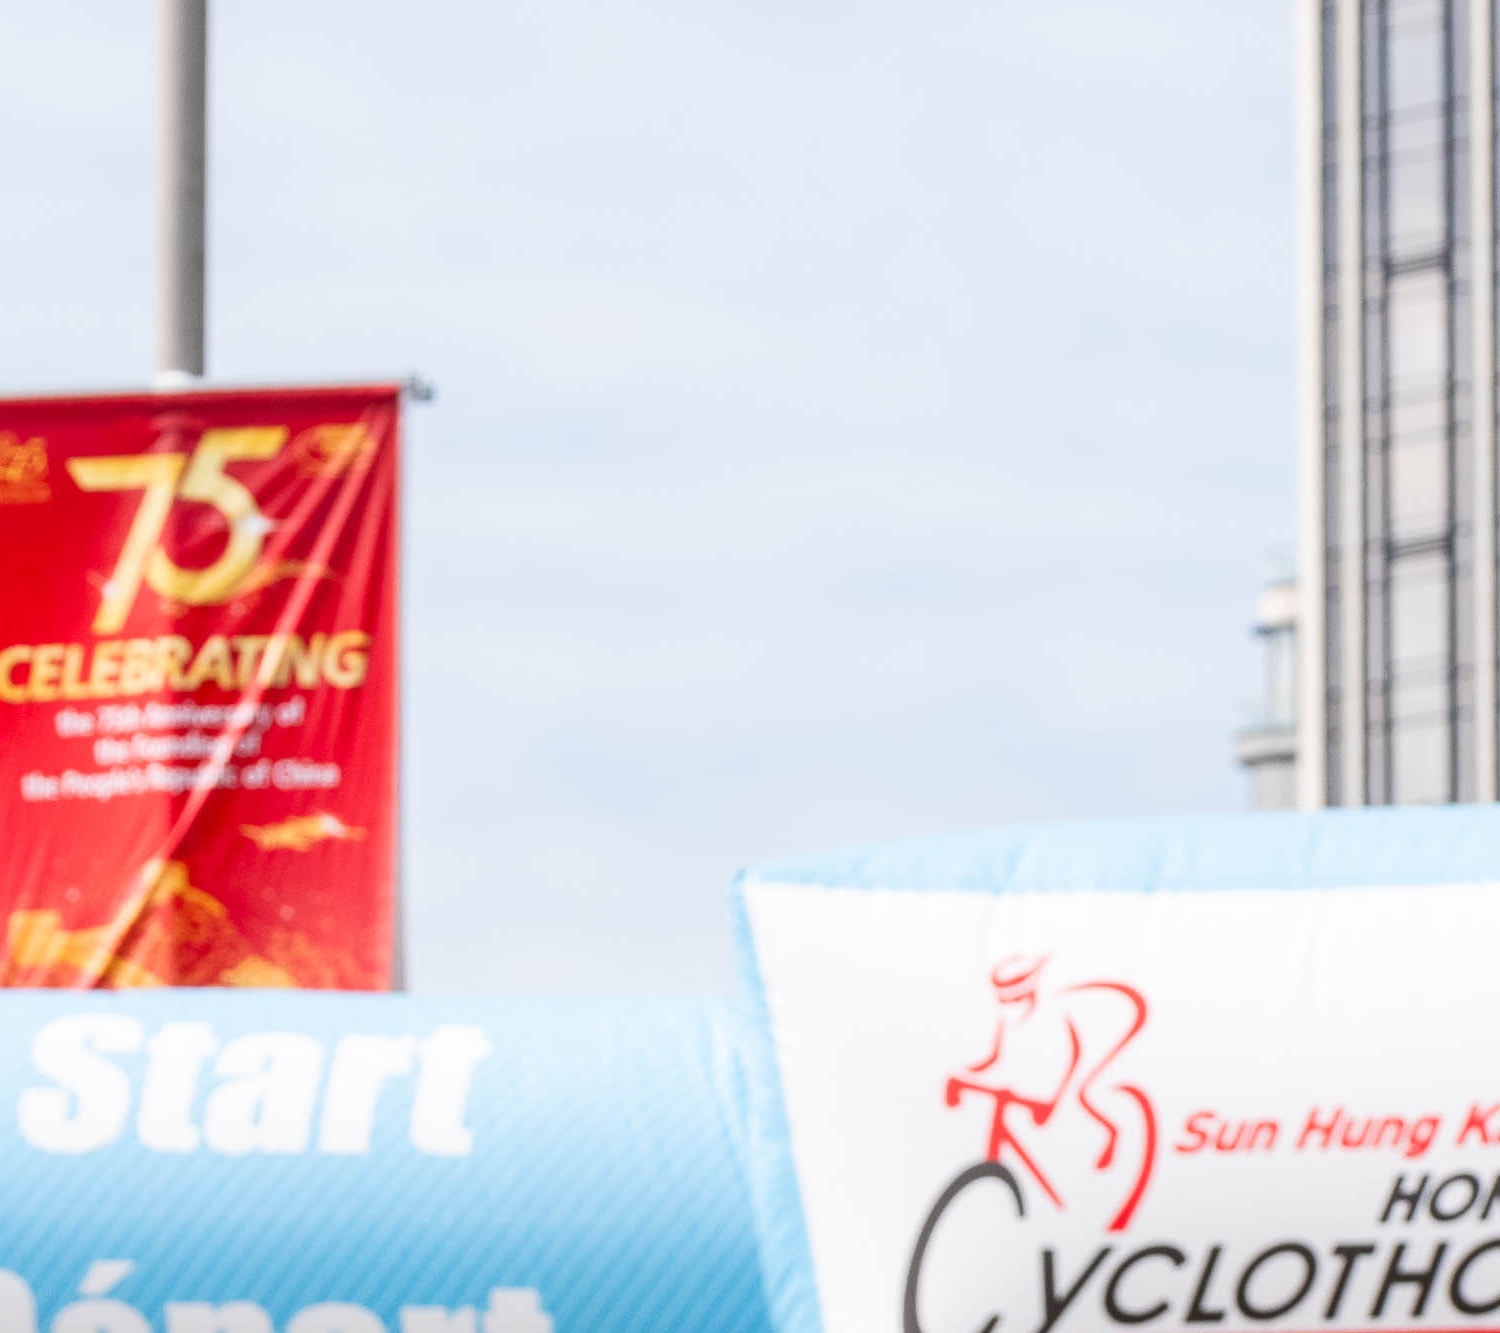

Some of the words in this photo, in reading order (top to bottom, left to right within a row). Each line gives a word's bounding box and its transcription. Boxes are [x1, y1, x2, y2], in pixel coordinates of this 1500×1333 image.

[67, 426, 290, 635] 75
[17, 1013, 492, 1157] Start
[1174, 1108, 1277, 1156] Sun
[1295, 1104, 1443, 1158] Hung
